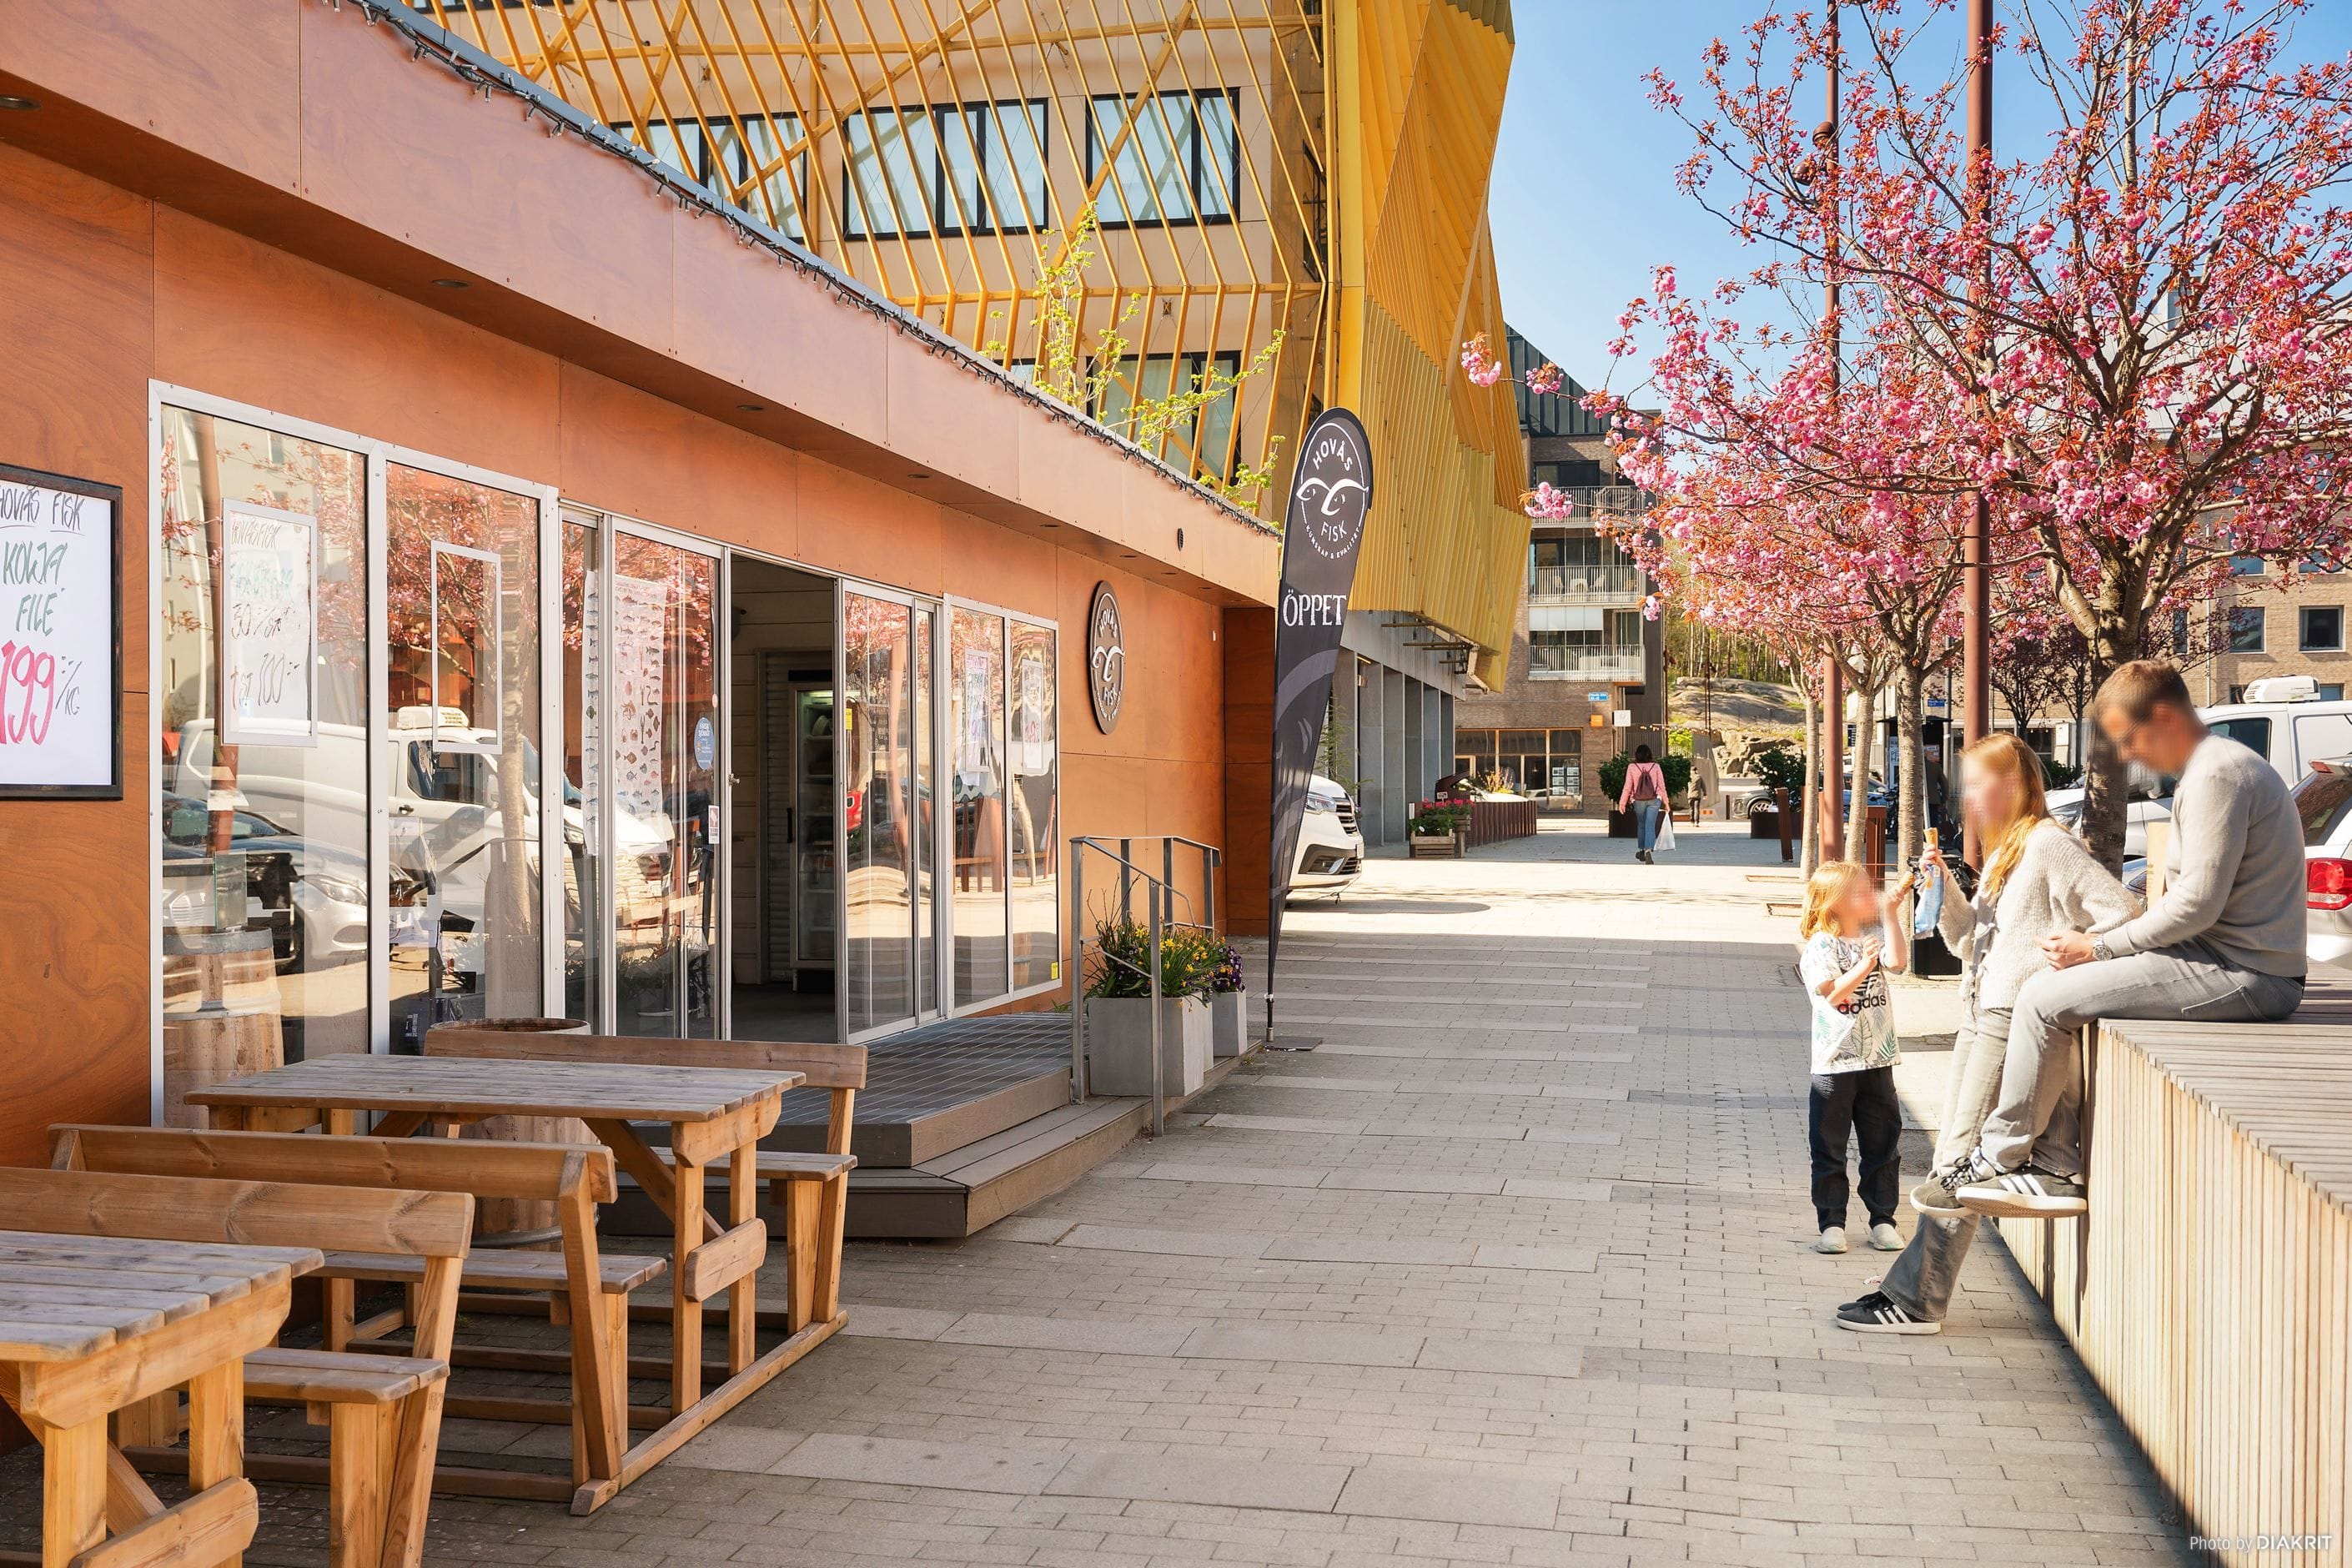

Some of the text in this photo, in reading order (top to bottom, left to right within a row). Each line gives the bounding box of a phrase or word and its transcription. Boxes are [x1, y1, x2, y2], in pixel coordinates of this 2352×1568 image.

[1312, 438, 1353, 472] HOVÅS
[52, 491, 85, 531] FISK
[1320, 520, 1348, 542] FISK
[1282, 588, 1347, 626] ÖPPET
[1103, 682, 1118, 706] FISK
